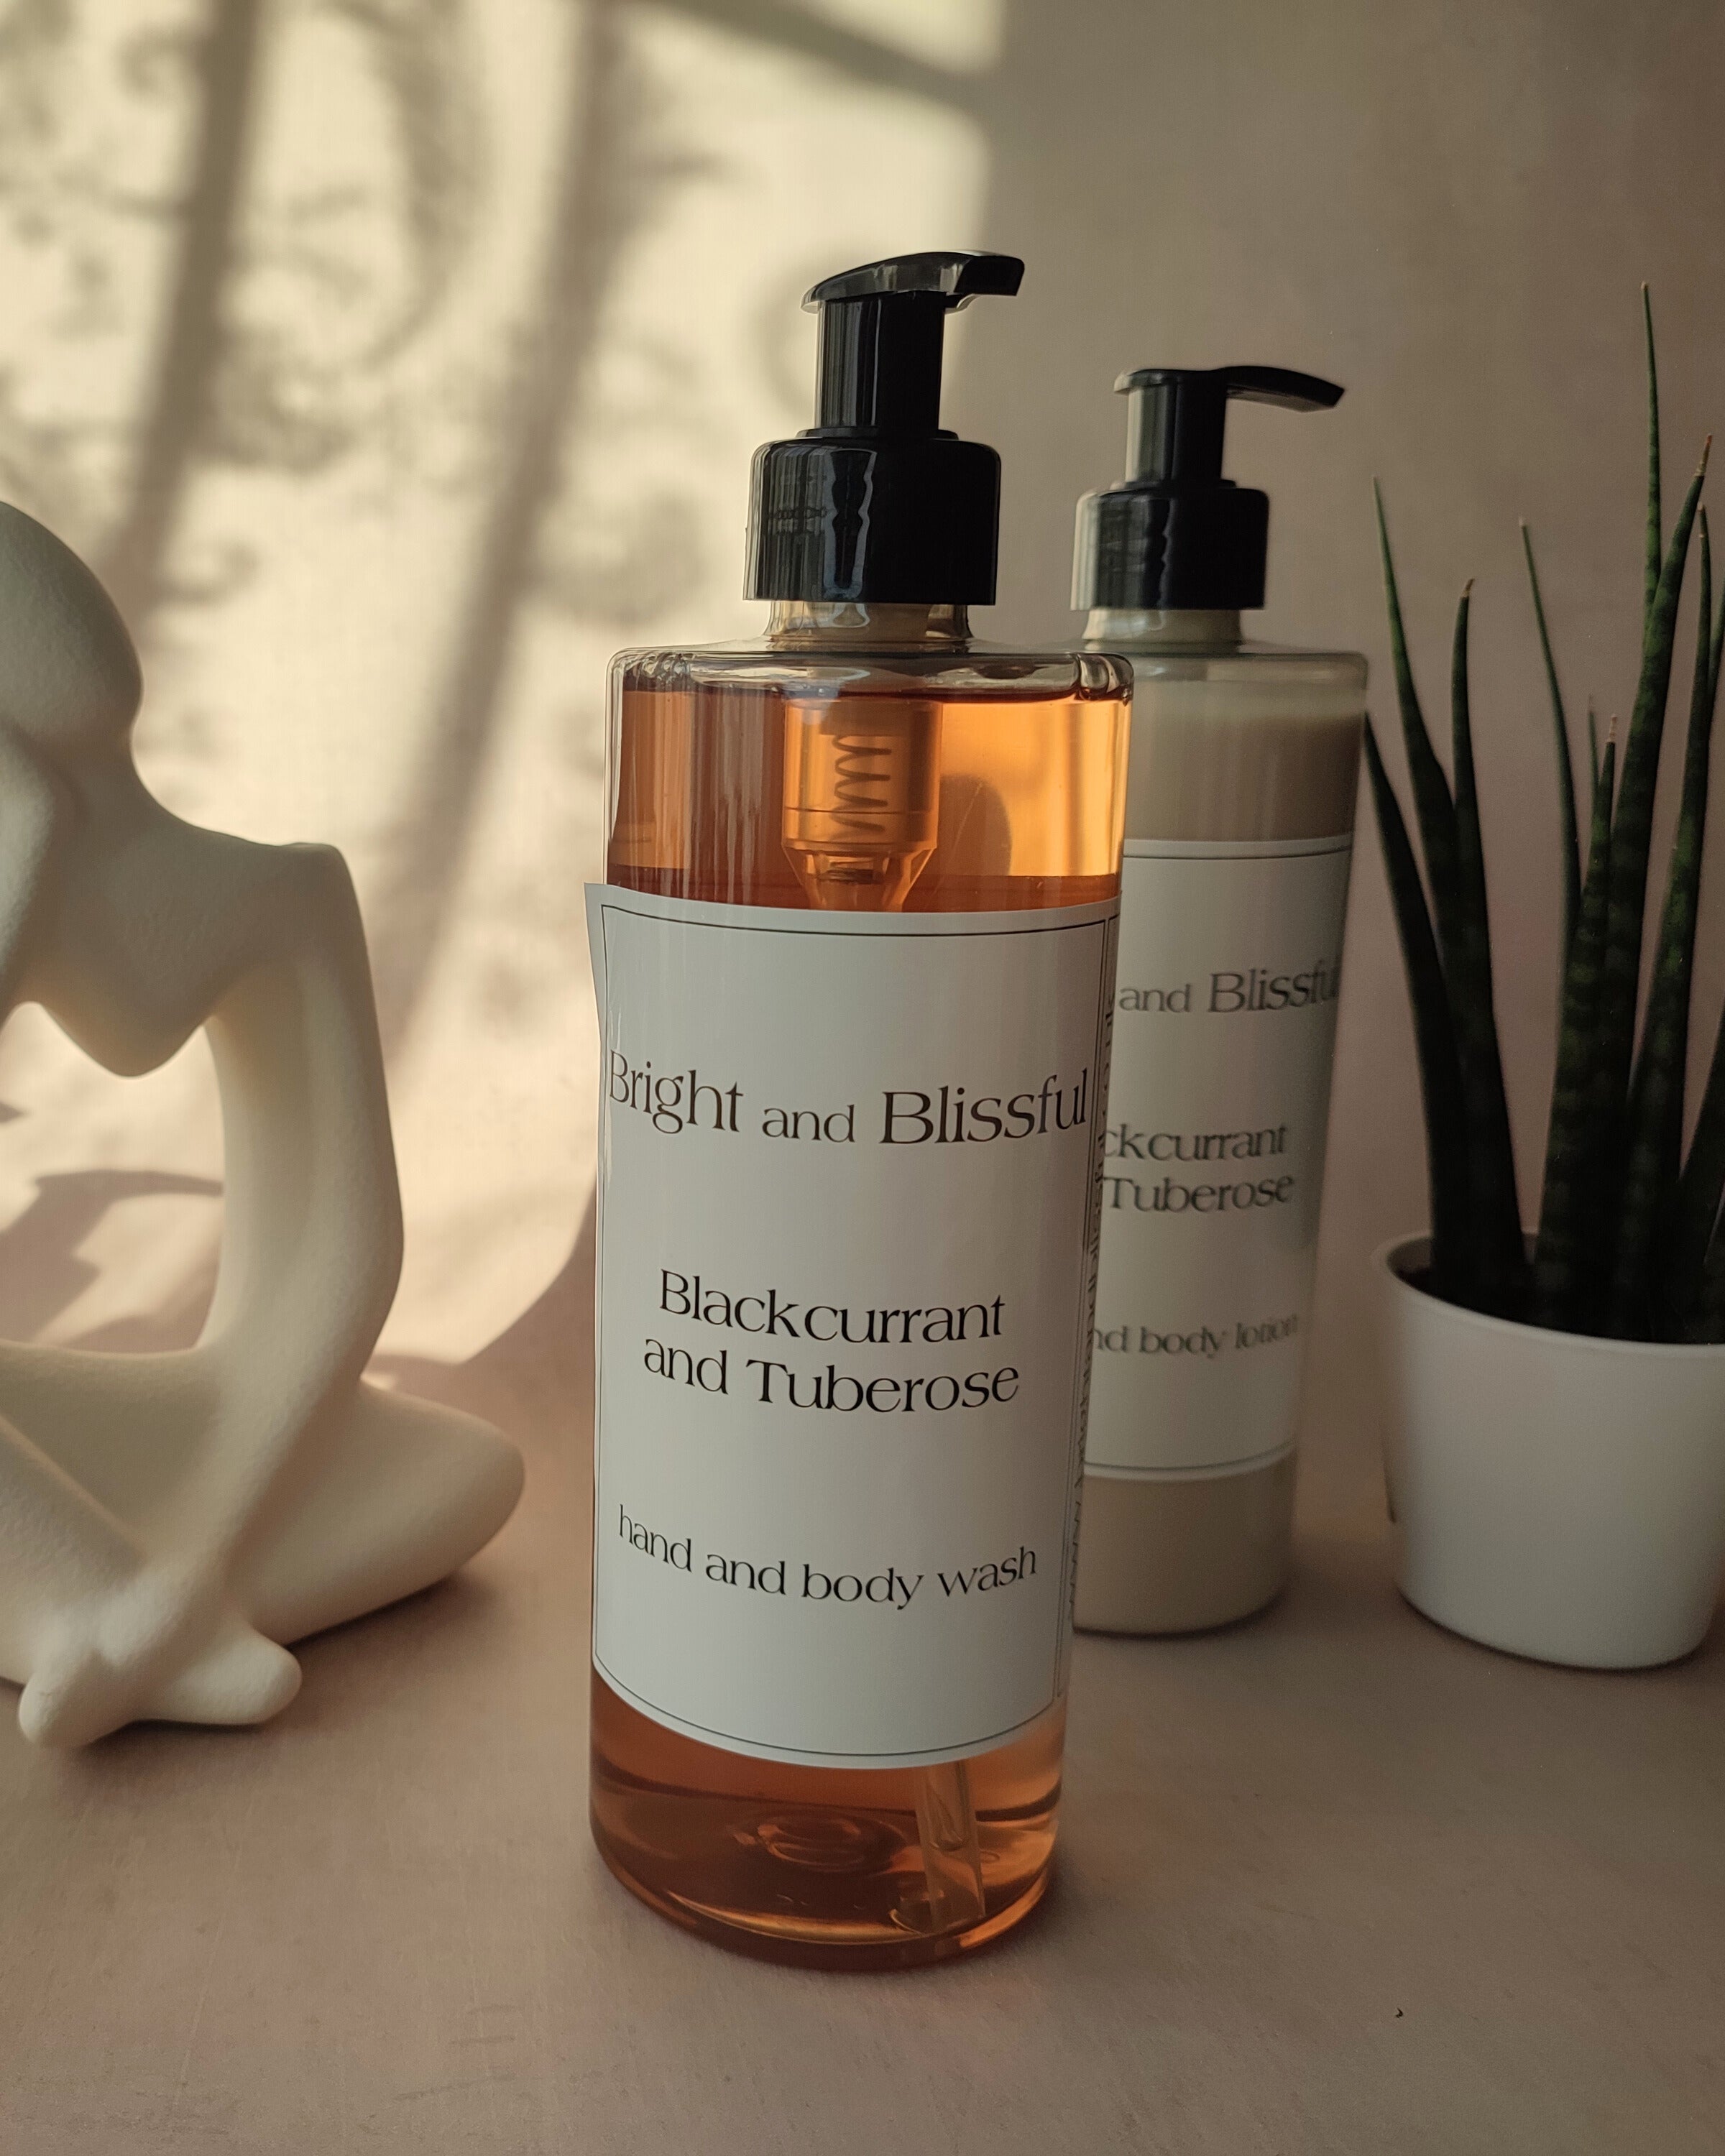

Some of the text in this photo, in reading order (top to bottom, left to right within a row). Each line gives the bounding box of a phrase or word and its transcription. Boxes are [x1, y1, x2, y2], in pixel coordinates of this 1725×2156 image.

[1119, 982, 1191, 1013] and
[610, 1050, 1090, 1145] Bright and Blissful
[1103, 1174, 1295, 1213] Tuberose
[660, 1268, 1006, 1345] Blackcurrant
[1139, 1326, 1228, 1360] body
[643, 1338, 1020, 1414] and Tuberose
[619, 1504, 1038, 1611] hand and body wash
